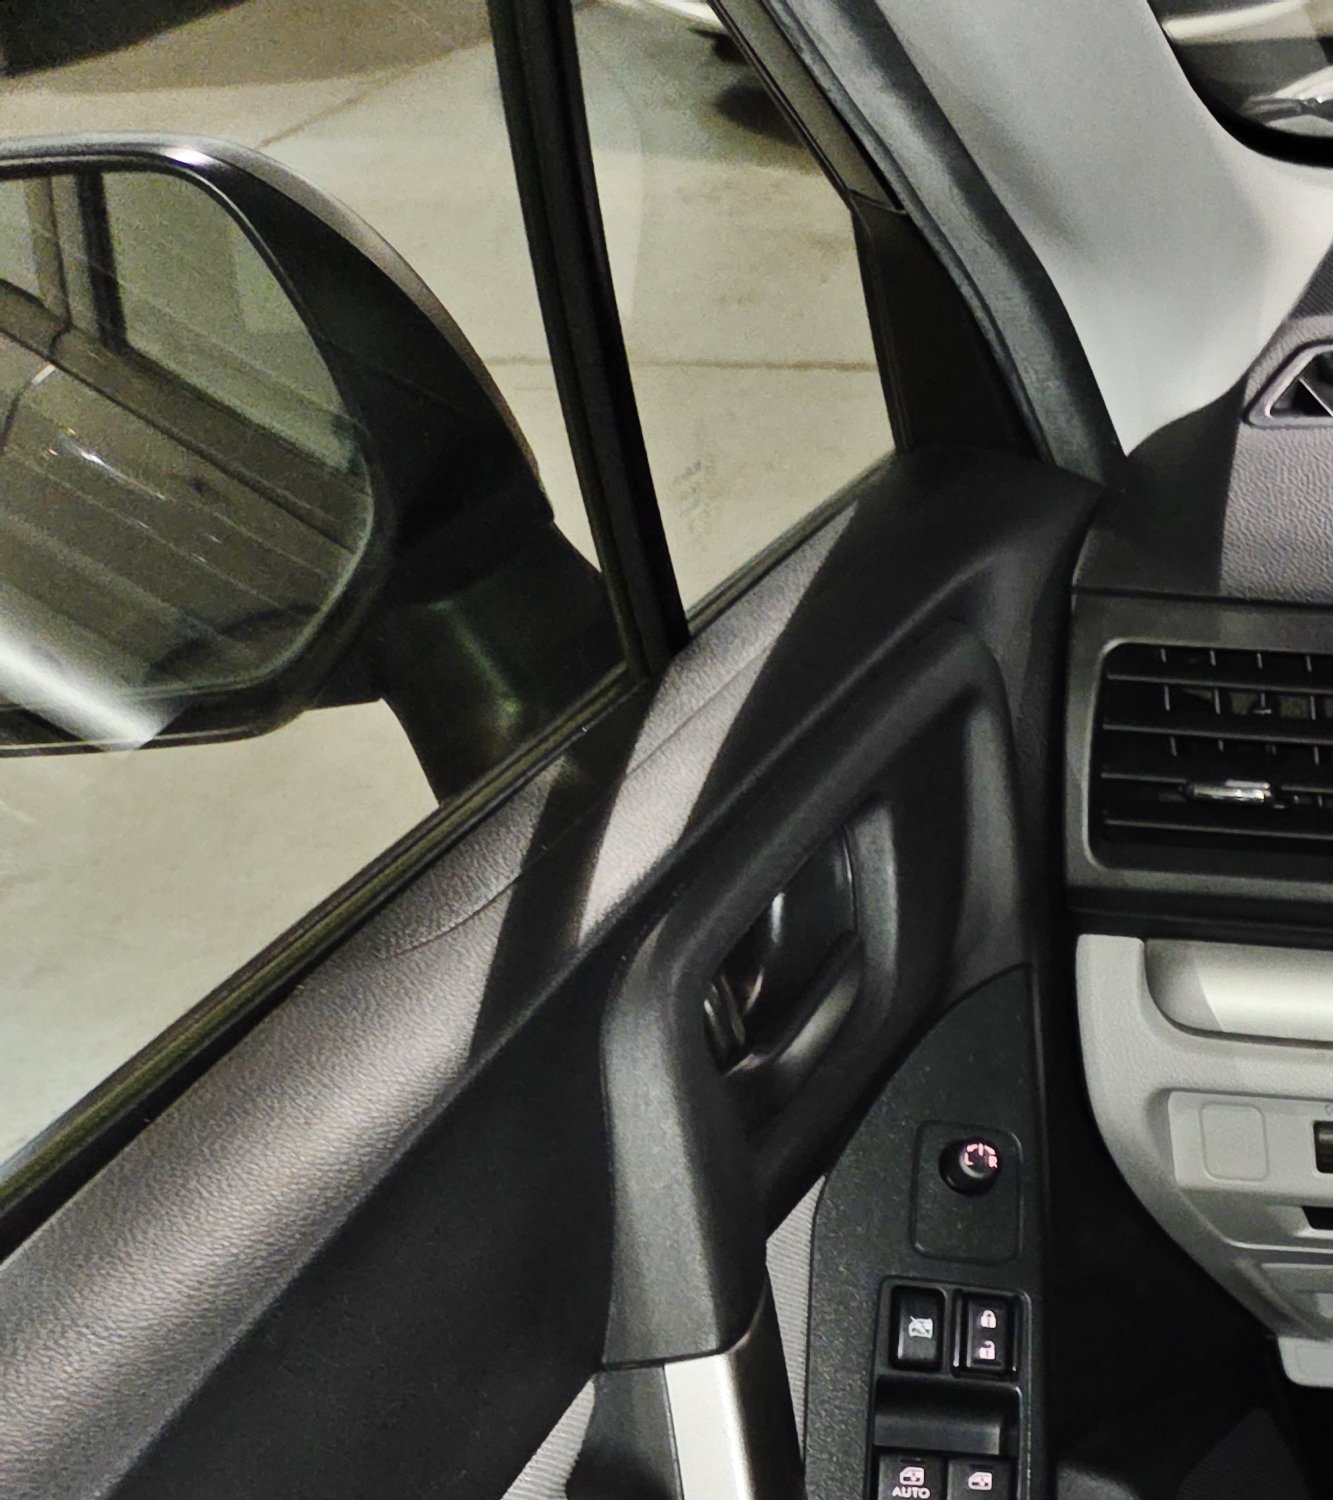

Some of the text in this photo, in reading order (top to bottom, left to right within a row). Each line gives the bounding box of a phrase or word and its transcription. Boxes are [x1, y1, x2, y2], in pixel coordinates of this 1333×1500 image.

[965, 1152, 974, 1166] L
[988, 1155, 998, 1168] R
[892, 1485, 930, 1499] AUTO
